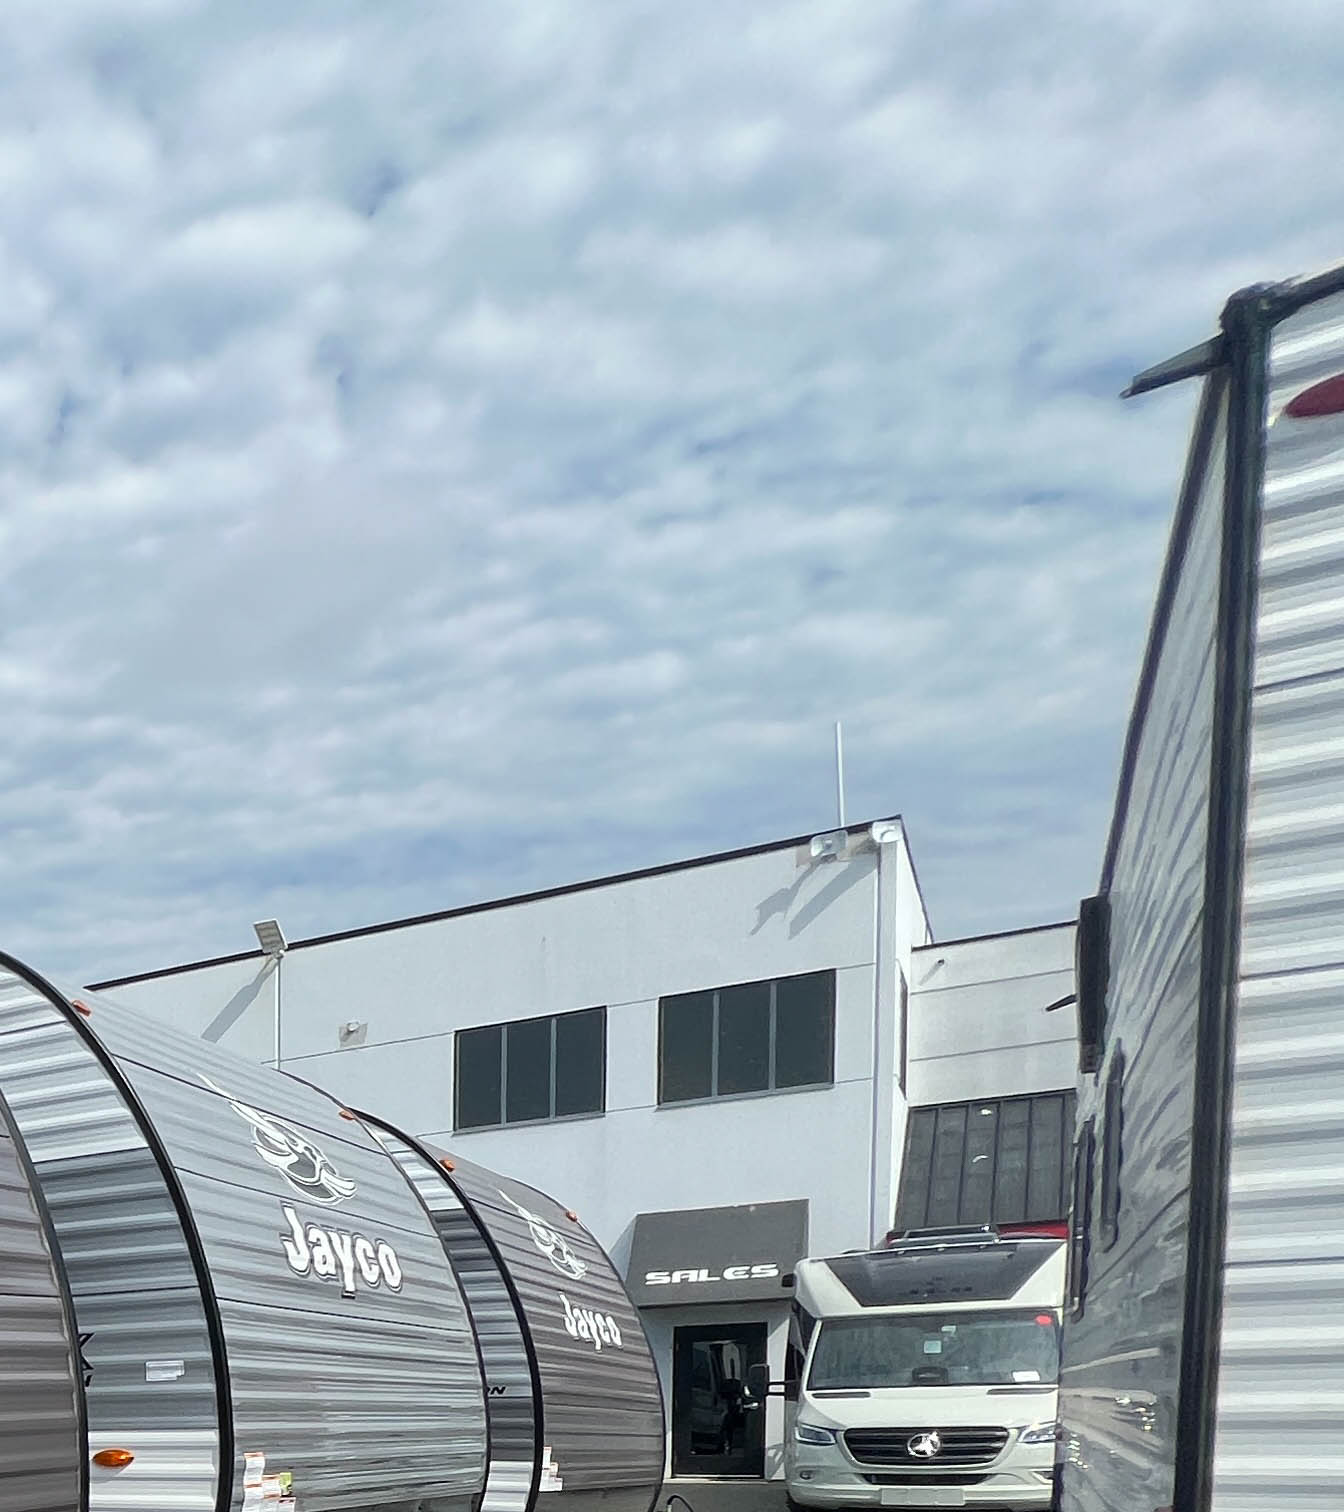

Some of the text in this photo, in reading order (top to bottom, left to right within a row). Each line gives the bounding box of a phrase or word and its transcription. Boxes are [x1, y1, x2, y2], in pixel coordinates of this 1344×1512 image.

[279, 1202, 403, 1299] Jayco
[644, 1264, 779, 1285] SALES
[559, 1292, 623, 1352] Jayco
